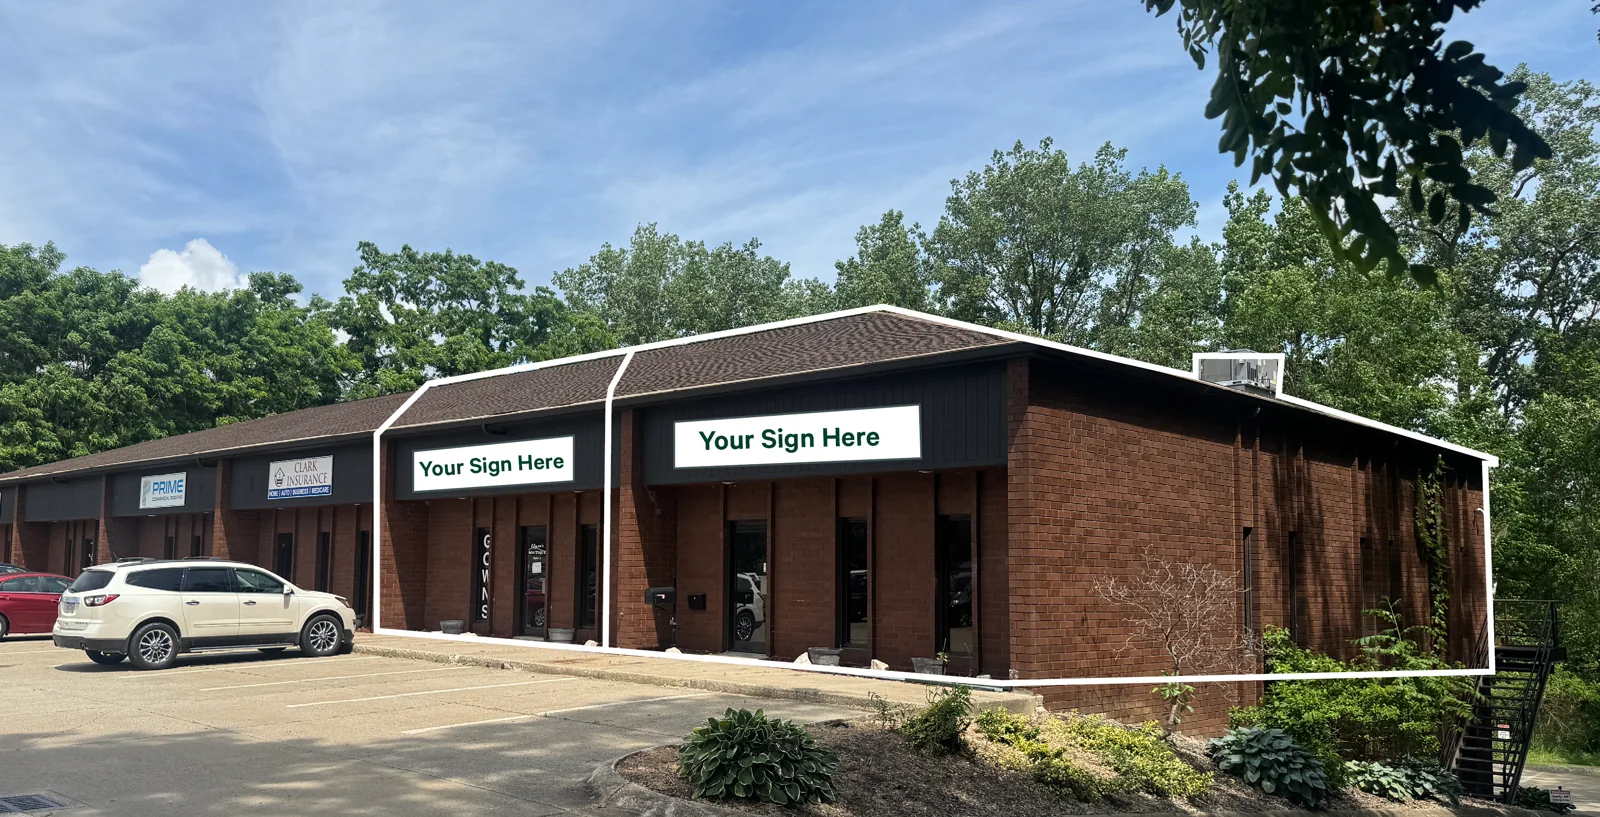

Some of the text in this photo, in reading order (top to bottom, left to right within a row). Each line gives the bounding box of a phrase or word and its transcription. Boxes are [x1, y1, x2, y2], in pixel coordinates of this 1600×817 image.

[294, 460, 317, 473] CLARK
[287, 473, 327, 486] INSURANCE
[152, 479, 183, 495] PRIME
[269, 489, 279, 497] HOME
[292, 487, 309, 495] BUSINESS
[311, 486, 330, 494] MEDICARE
